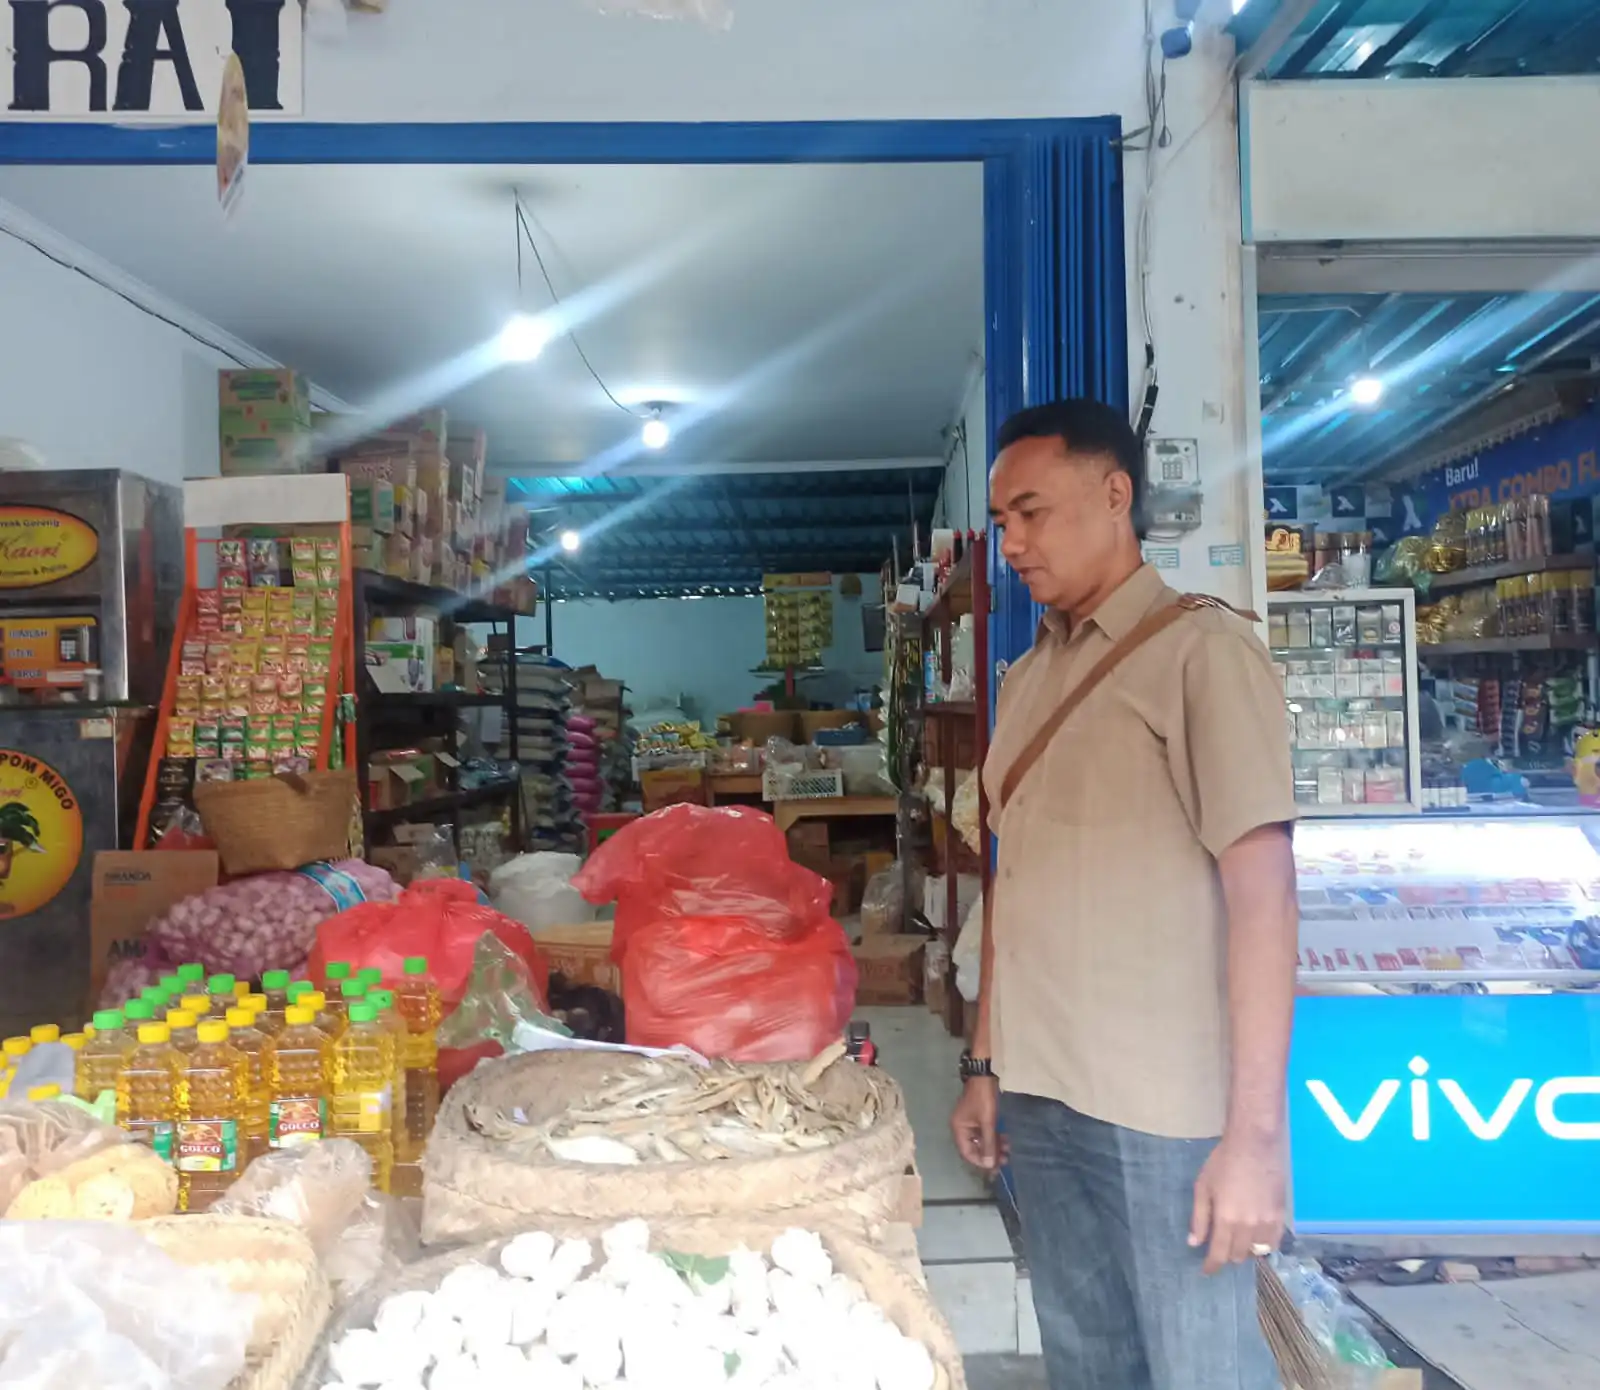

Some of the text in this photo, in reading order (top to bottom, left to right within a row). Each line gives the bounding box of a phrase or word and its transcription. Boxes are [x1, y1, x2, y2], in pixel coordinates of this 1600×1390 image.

[1445, 456, 1479, 487] Baru!
[1499, 460, 1571, 504] COMBO
[39, 769, 74, 811] MIGO
